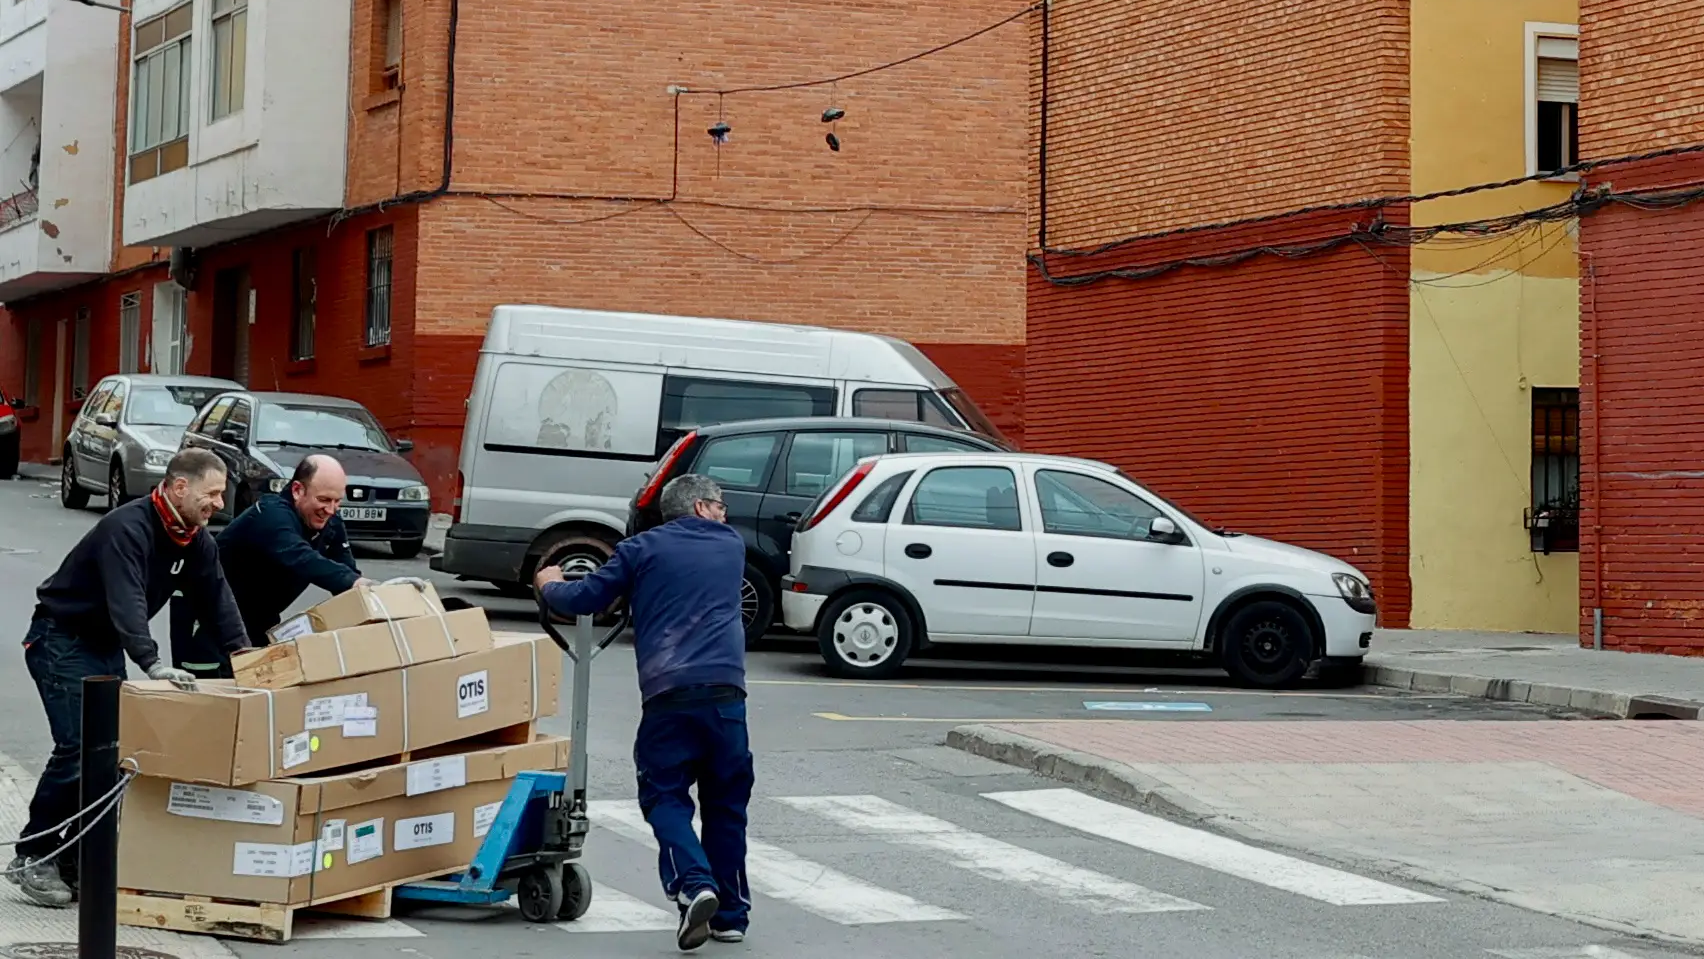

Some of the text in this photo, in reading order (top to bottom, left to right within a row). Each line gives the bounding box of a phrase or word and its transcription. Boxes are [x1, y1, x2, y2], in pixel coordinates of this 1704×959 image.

[342, 508, 361, 519] 901
[459, 679, 485, 700] OTIS
[413, 821, 434, 836] OTIS
